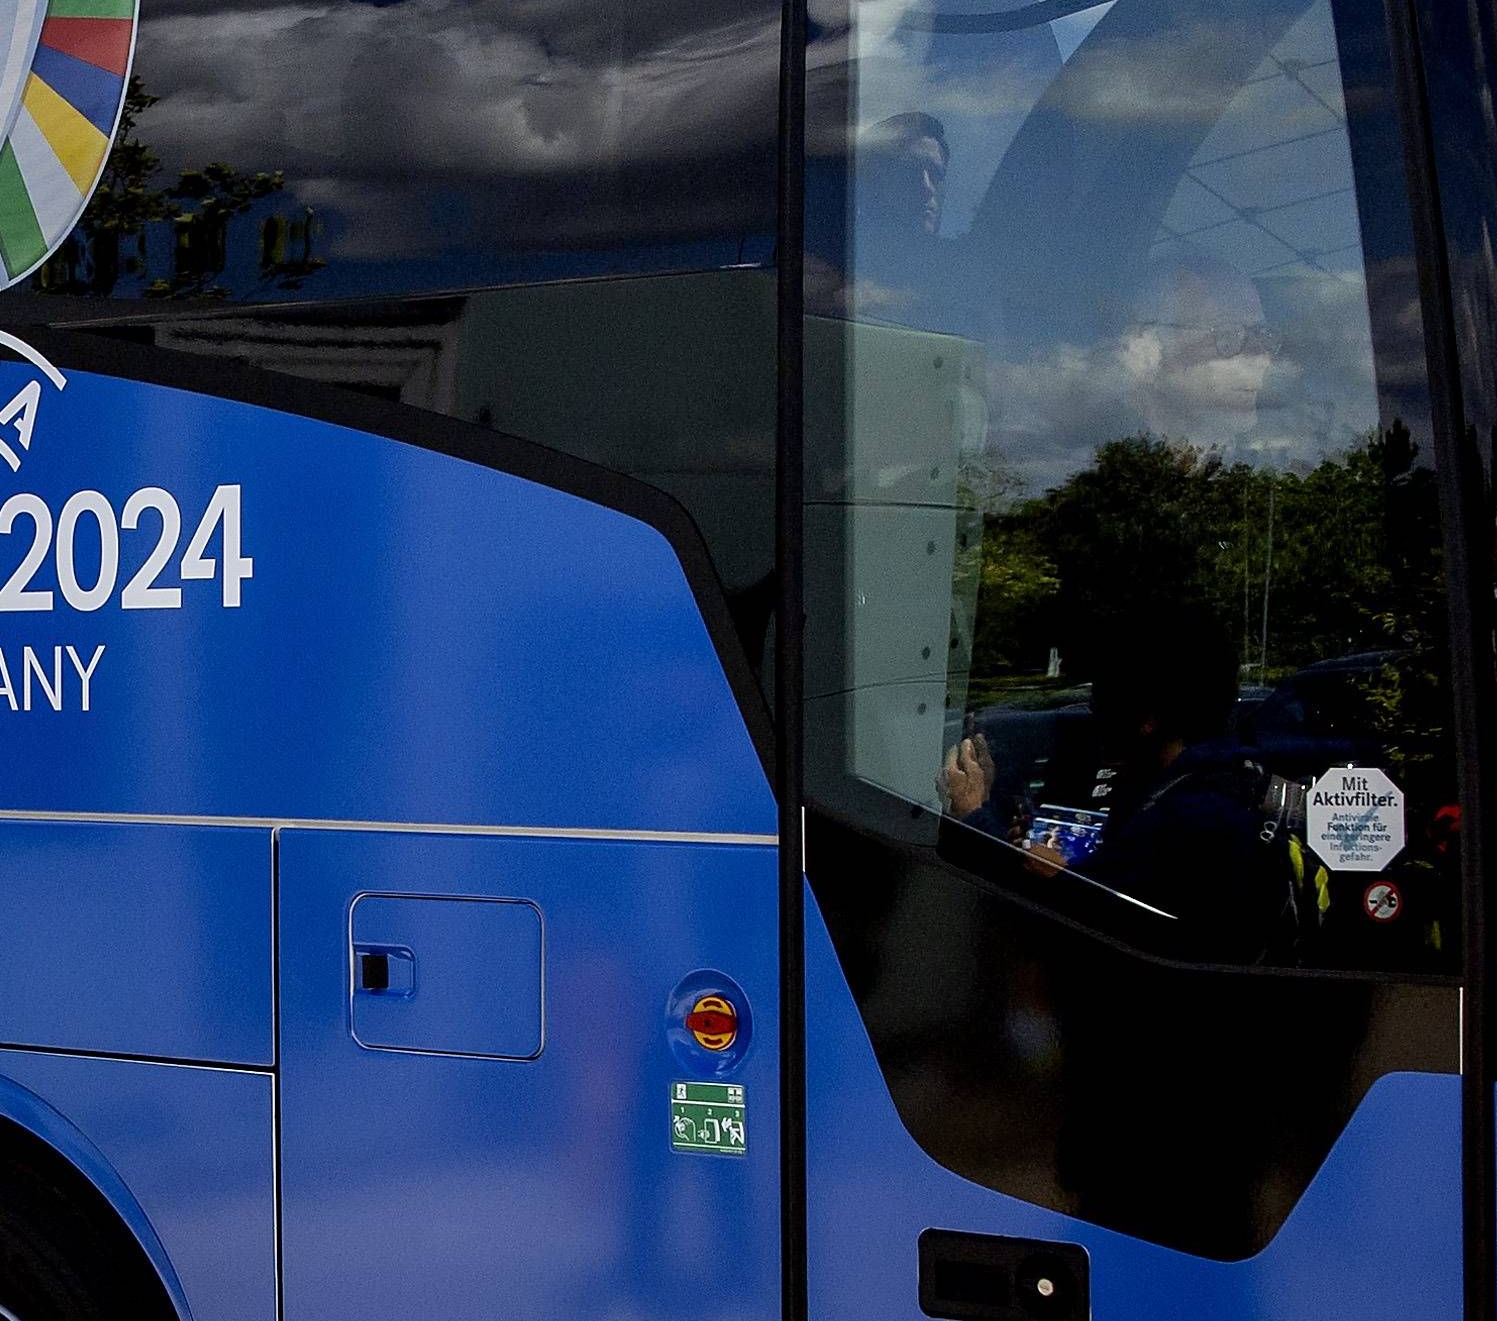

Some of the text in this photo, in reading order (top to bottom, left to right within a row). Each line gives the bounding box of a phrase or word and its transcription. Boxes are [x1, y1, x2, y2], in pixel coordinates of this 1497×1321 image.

[1342, 776, 1368, 791] Mit
[1313, 792, 1398, 807] Aktivfilter.
[1373, 822, 1388, 832] für
